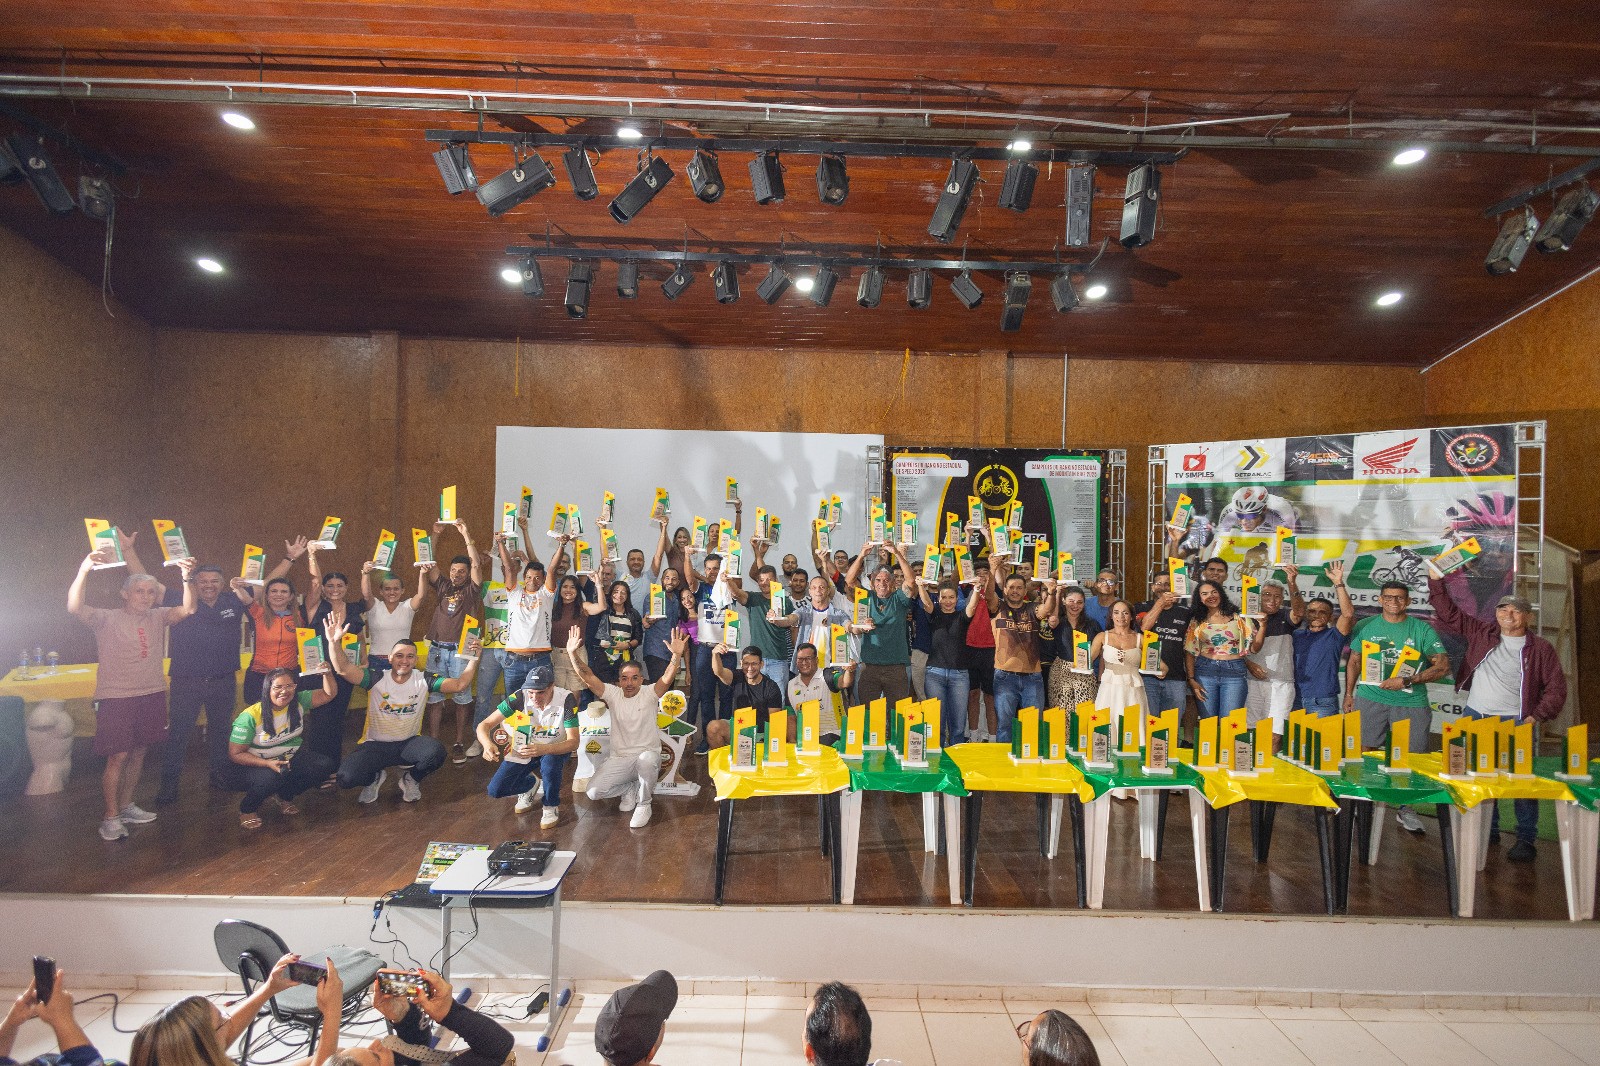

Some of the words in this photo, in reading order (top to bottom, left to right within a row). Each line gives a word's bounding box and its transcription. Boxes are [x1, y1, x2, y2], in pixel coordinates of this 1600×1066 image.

[1362, 467, 1421, 476] HONDA
[1023, 534, 1045, 544] CBC
[1350, 593, 1367, 602] DE
[1441, 703, 1465, 715] CB
